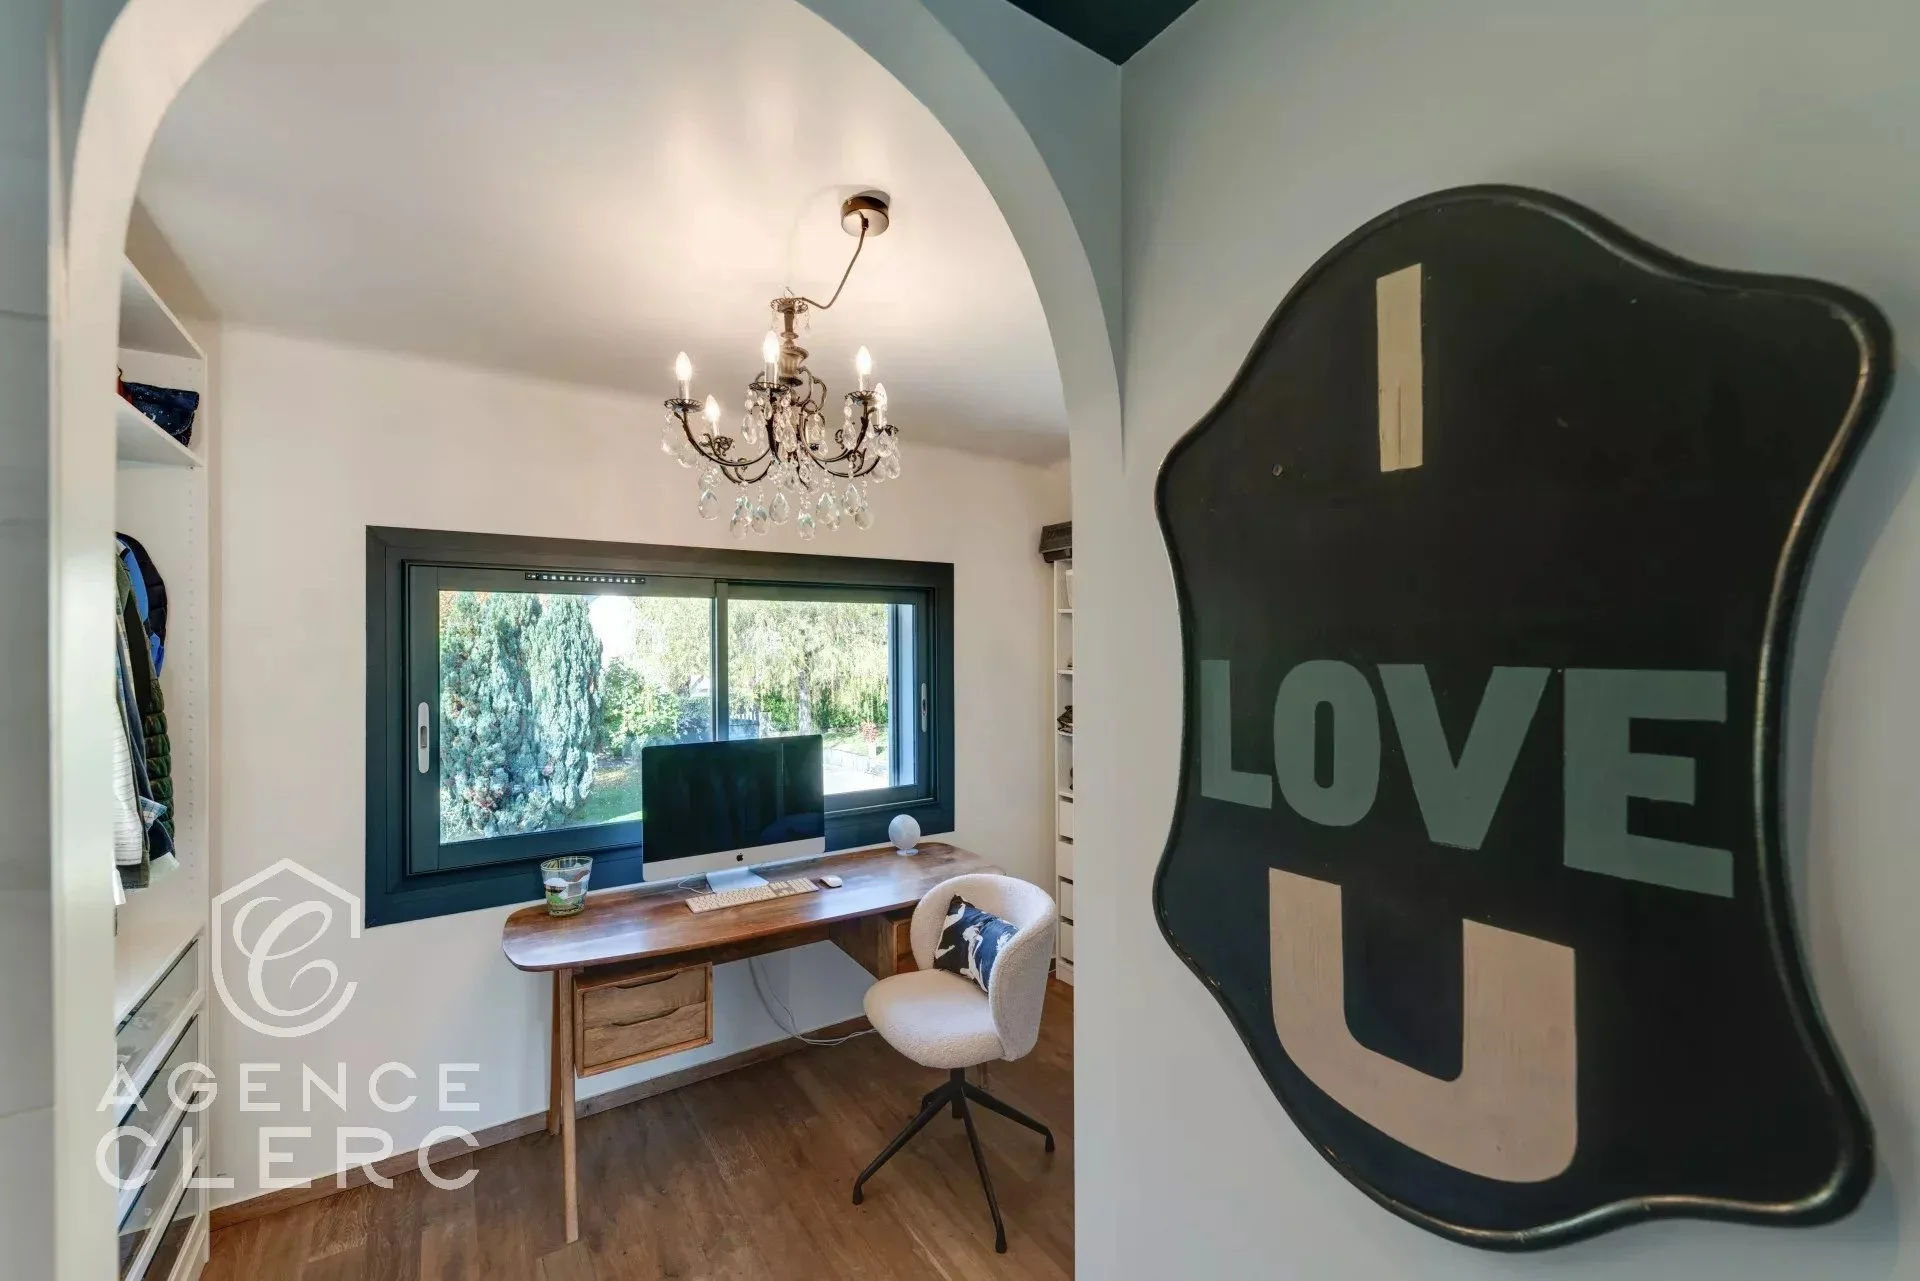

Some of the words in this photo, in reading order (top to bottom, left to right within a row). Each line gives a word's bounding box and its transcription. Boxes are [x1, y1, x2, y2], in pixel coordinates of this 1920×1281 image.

[1376, 263, 1423, 472] I
[1201, 659, 1734, 898] LOVE
[1269, 867, 1578, 1184] U
